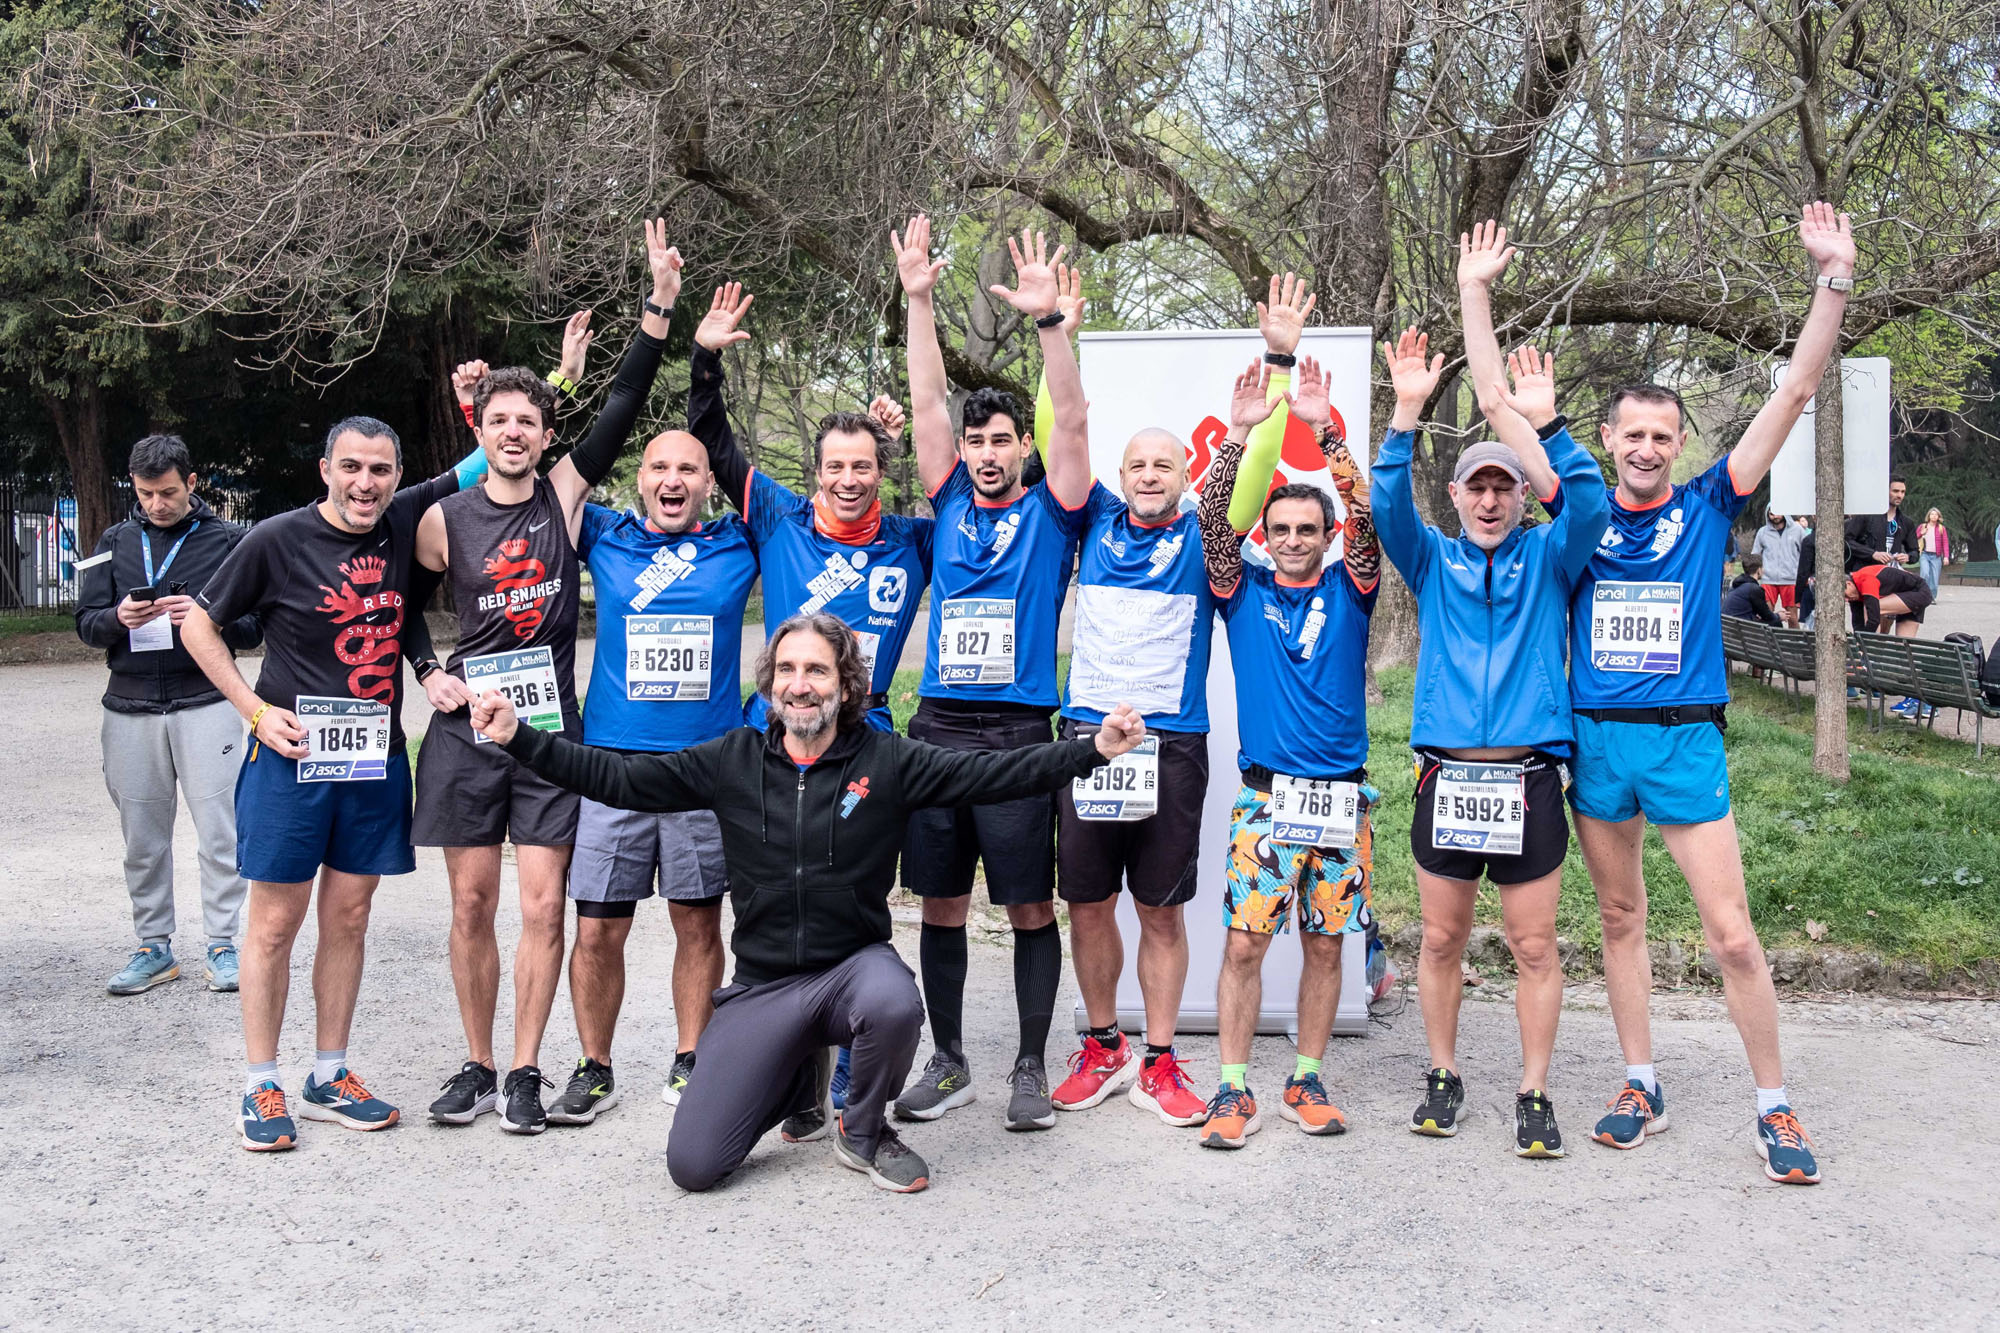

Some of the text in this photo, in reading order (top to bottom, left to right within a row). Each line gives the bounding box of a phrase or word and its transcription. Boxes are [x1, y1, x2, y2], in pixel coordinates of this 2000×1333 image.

[1596, 546, 1621, 559] refour
[651, 545, 697, 581] SPORT
[634, 563, 663, 590] SENZA
[825, 551, 867, 591] SPORT
[806, 567, 838, 595] SENZA
[478, 578, 562, 611] RED SNAKES
[629, 567, 679, 613] FRONTIERE
[799, 578, 848, 616] FRONTIERE
[1596, 587, 1680, 600] enel MILANO
[363, 593, 402, 610] RED
[511, 601, 534, 613] MILANO
[944, 604, 1012, 618] enel MILANO
[1624, 605, 1648, 613] ALBERTO
[347, 620, 400, 635] SNAKES
[630, 620, 710, 633] enel MILANO
[1609, 616, 1662, 642] 3884
[657, 637, 682, 645] PASQUALE
[956, 631, 990, 656] 827
[337, 645, 370, 662] MILANO
[645, 648, 694, 672] 5230
[1608, 654, 1638, 667] asics
[468, 653, 549, 676] enel MILANO
[500, 674, 521, 684] DANIELE
[950, 667, 976, 679] asics
[644, 684, 674, 696] asics
[300, 703, 334, 713] enel
[318, 727, 368, 752] 1845
[316, 765, 347, 776] asics
[1442, 768, 1468, 780] enel
[1093, 766, 1137, 791] 5192
[1459, 785, 1498, 794] MASSIMILIANO
[1089, 804, 1117, 814] asics
[1298, 790, 1333, 817] 768
[1454, 795, 1505, 823] 5992
[1288, 827, 1317, 840] asics
[1452, 833, 1482, 846] asics
